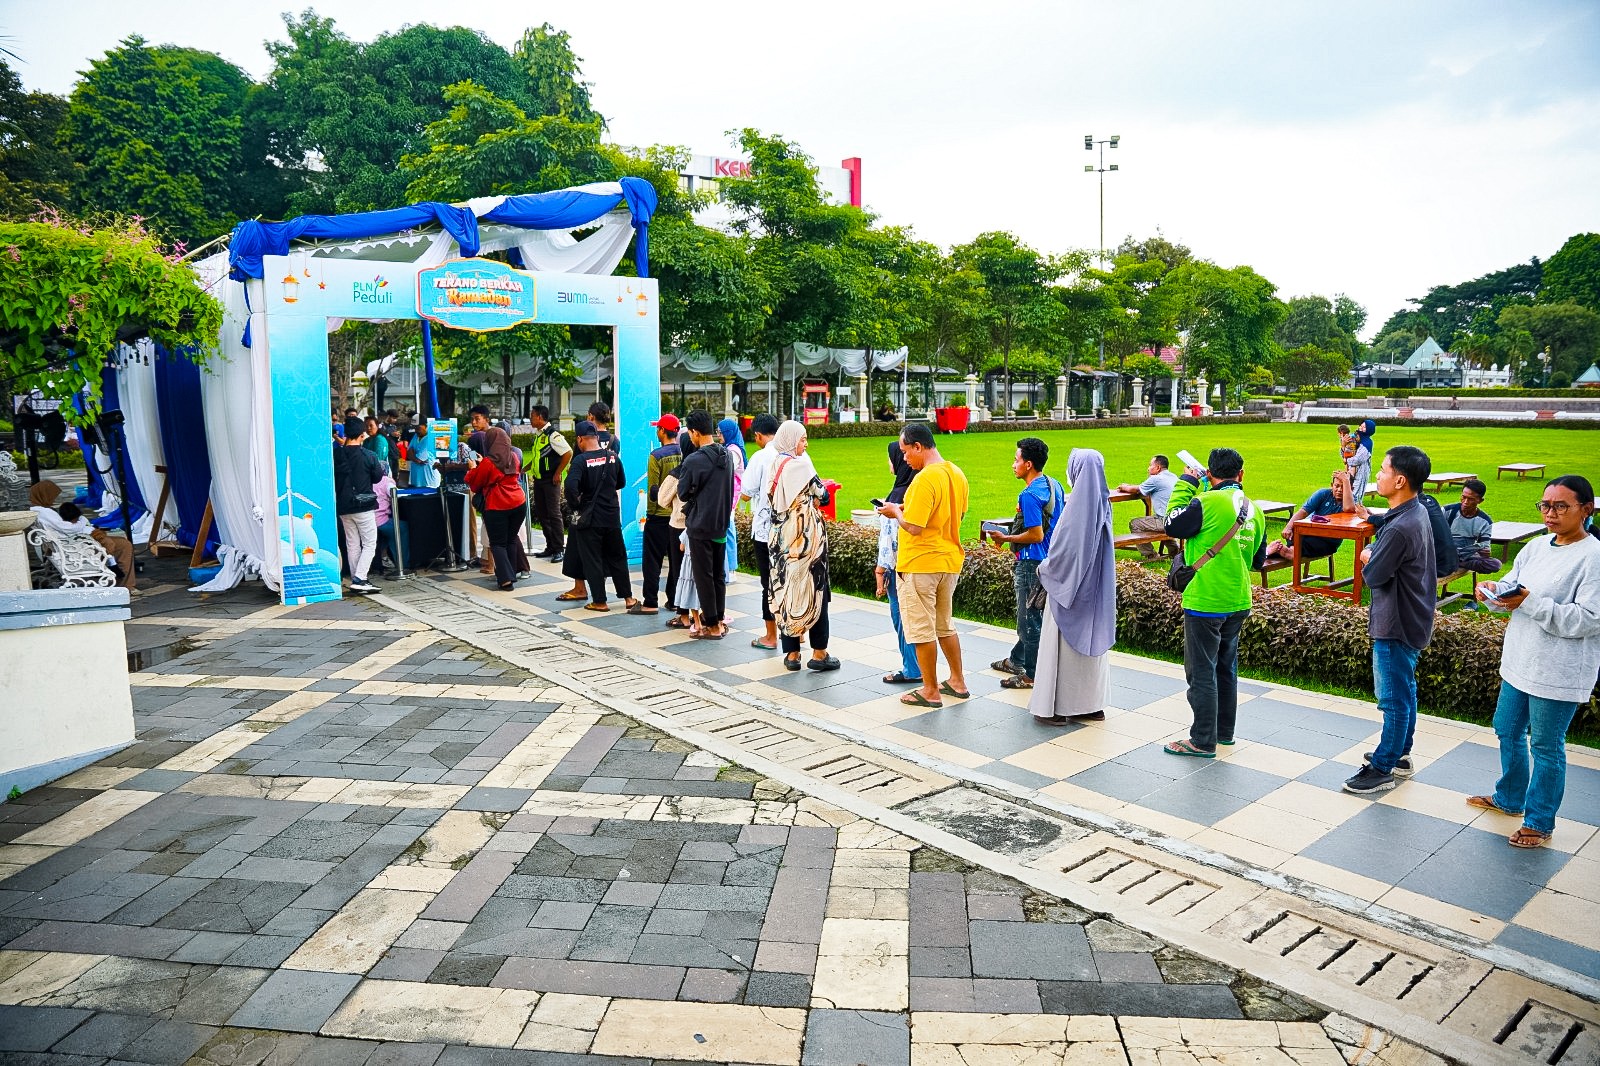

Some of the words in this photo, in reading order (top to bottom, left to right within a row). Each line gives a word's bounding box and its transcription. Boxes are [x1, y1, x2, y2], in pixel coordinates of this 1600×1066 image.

[715, 158, 752, 178] KEN
[353, 281, 373, 292] PLN
[479, 278, 523, 292] BERKAH
[353, 290, 392, 304] Peduli
[447, 289, 512, 307] Ramadan
